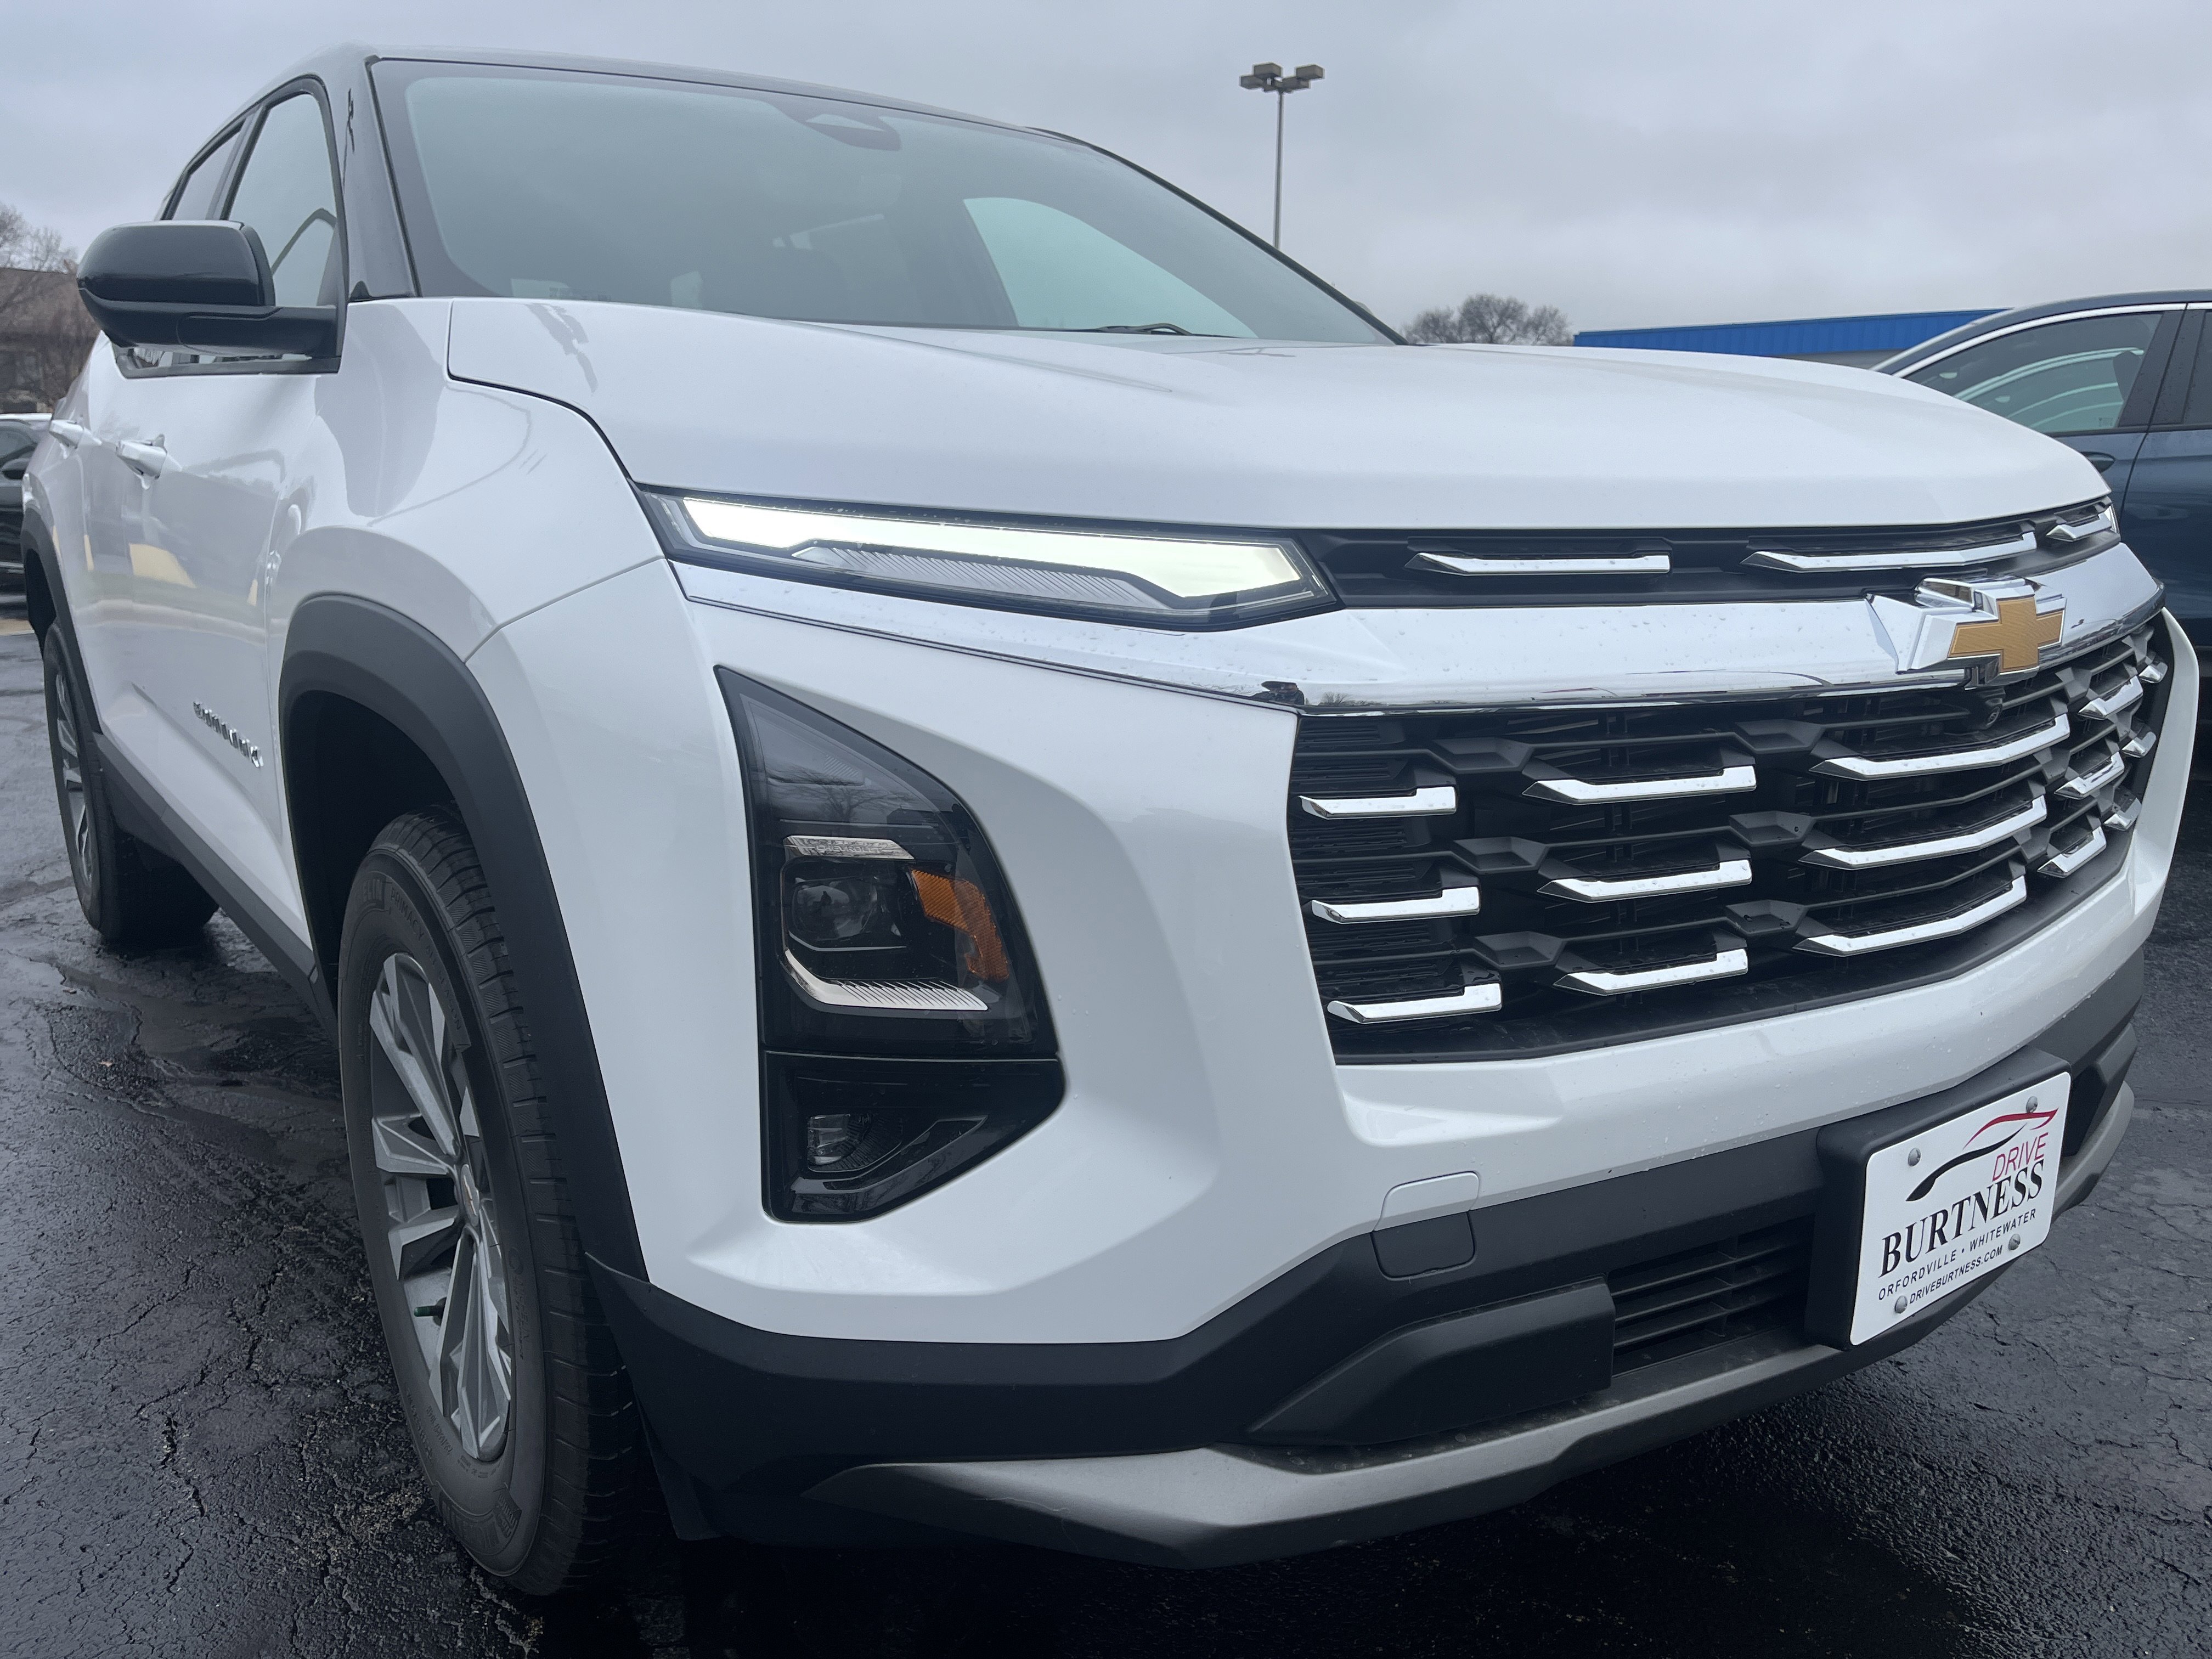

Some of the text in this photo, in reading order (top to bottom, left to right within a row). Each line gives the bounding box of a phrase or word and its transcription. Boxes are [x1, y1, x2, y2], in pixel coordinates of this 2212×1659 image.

[391, 887, 425, 941] PRIMACY
[1992, 1132, 2049, 1181] DRIVE
[1878, 1159, 2045, 1278] BURTNESS
[1878, 1208, 2036, 1301] ORFORDVILLE WHITEWATER
[1909, 1245, 2003, 1304] DRIVEBURTNESS.COM
